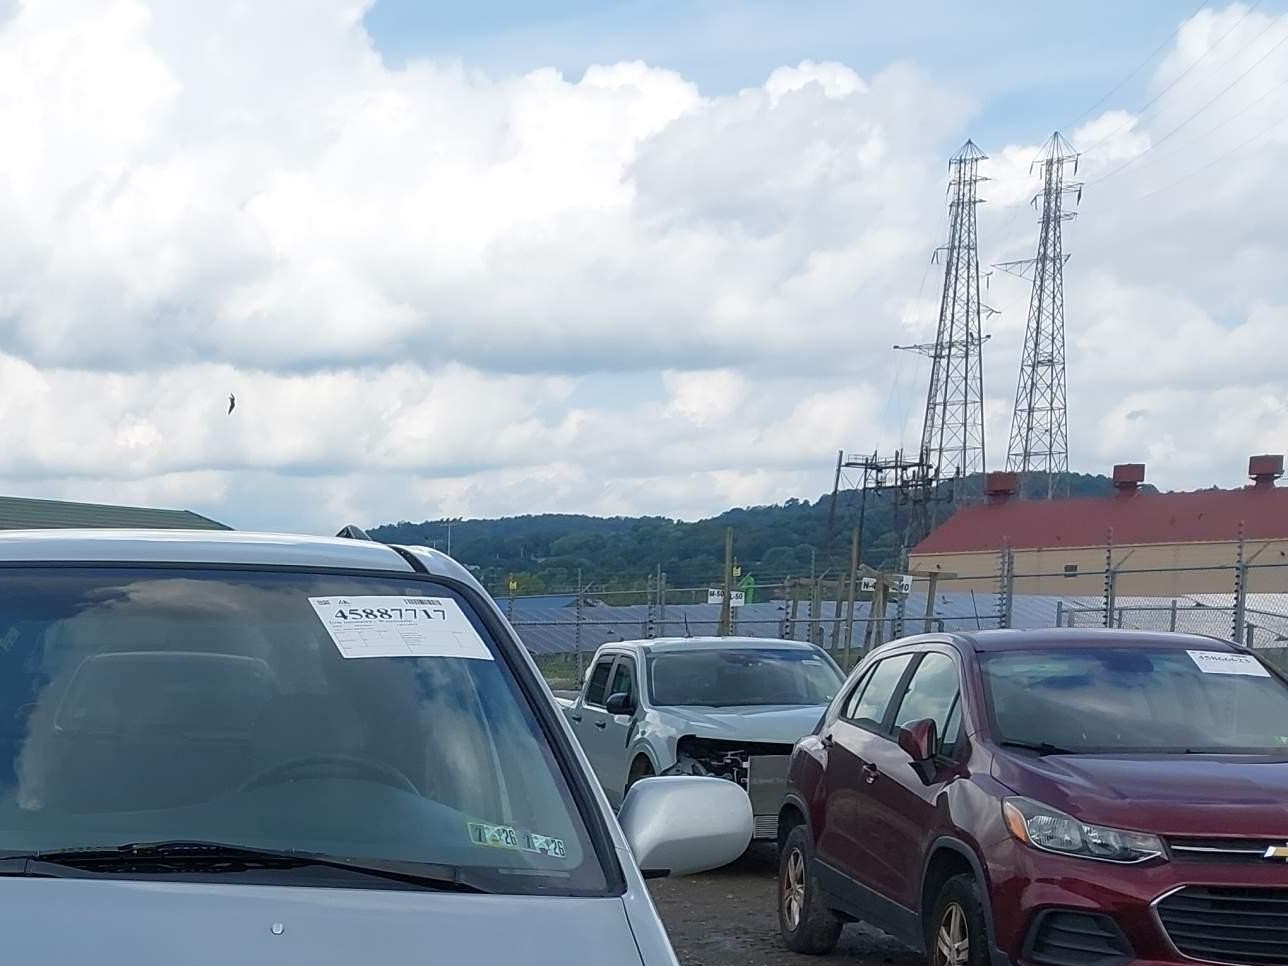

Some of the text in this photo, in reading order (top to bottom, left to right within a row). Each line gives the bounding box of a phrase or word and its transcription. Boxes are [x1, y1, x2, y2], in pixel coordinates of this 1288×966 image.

[334, 608, 446, 621] 45887717
[502, 828, 517, 846] 26
[551, 839, 565, 857] 26
